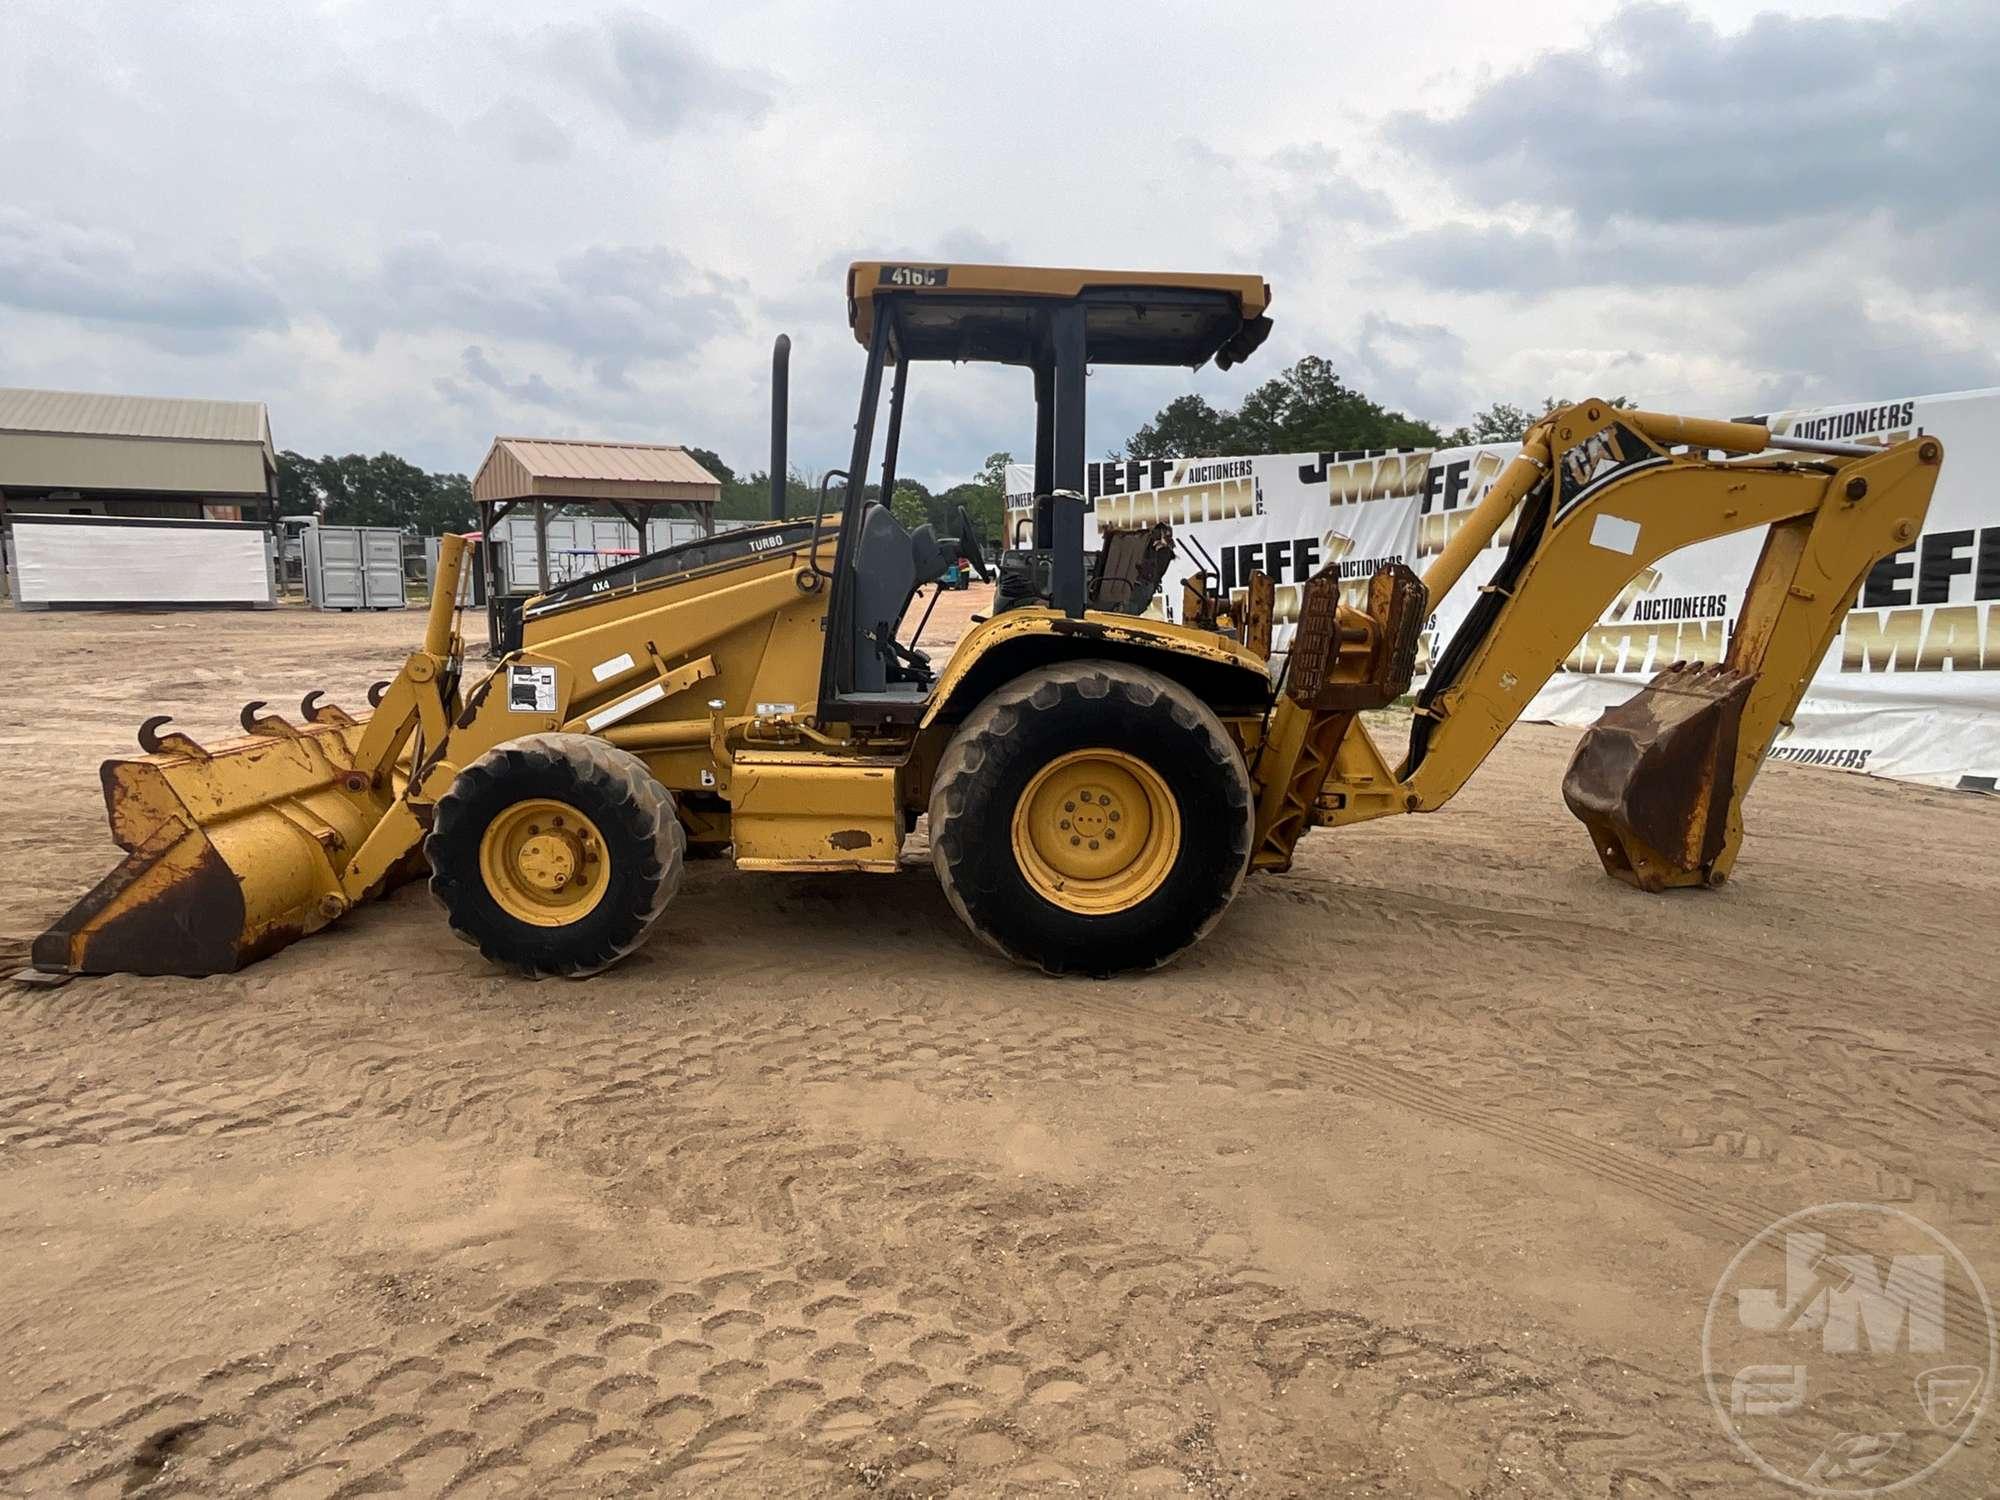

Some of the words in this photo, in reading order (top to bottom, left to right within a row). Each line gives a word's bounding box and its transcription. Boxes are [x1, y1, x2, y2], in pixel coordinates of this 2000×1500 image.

[1794, 402, 1914, 441] AUCTIONEERS
[1189, 459, 1253, 484] AUCTIONEERS
[1097, 478, 1253, 534] MARTIN
[749, 534, 783, 551] TURBO
[592, 580, 610, 592] 4X4
[1633, 594, 1727, 621] AUCTIONEERS
